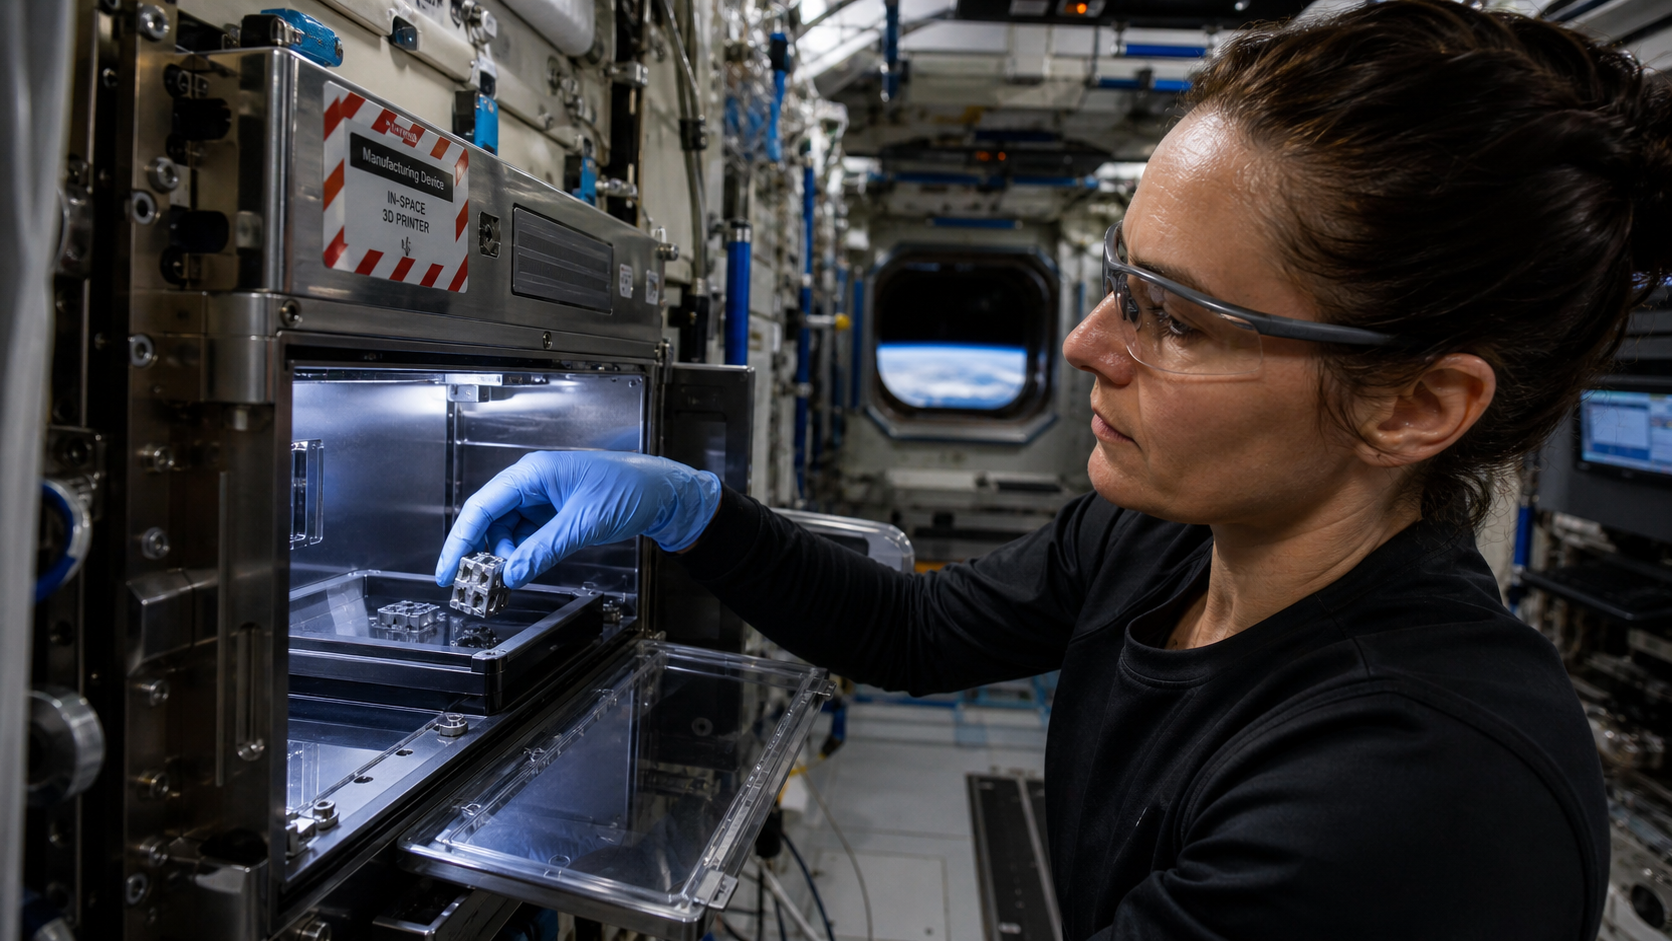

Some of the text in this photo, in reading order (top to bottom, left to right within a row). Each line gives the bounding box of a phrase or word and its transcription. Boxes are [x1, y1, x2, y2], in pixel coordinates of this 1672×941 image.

[362, 146, 445, 190] Manufacturing Device
[387, 190, 426, 215] IN-SPACE
[382, 208, 430, 234] 3D PRINTER
